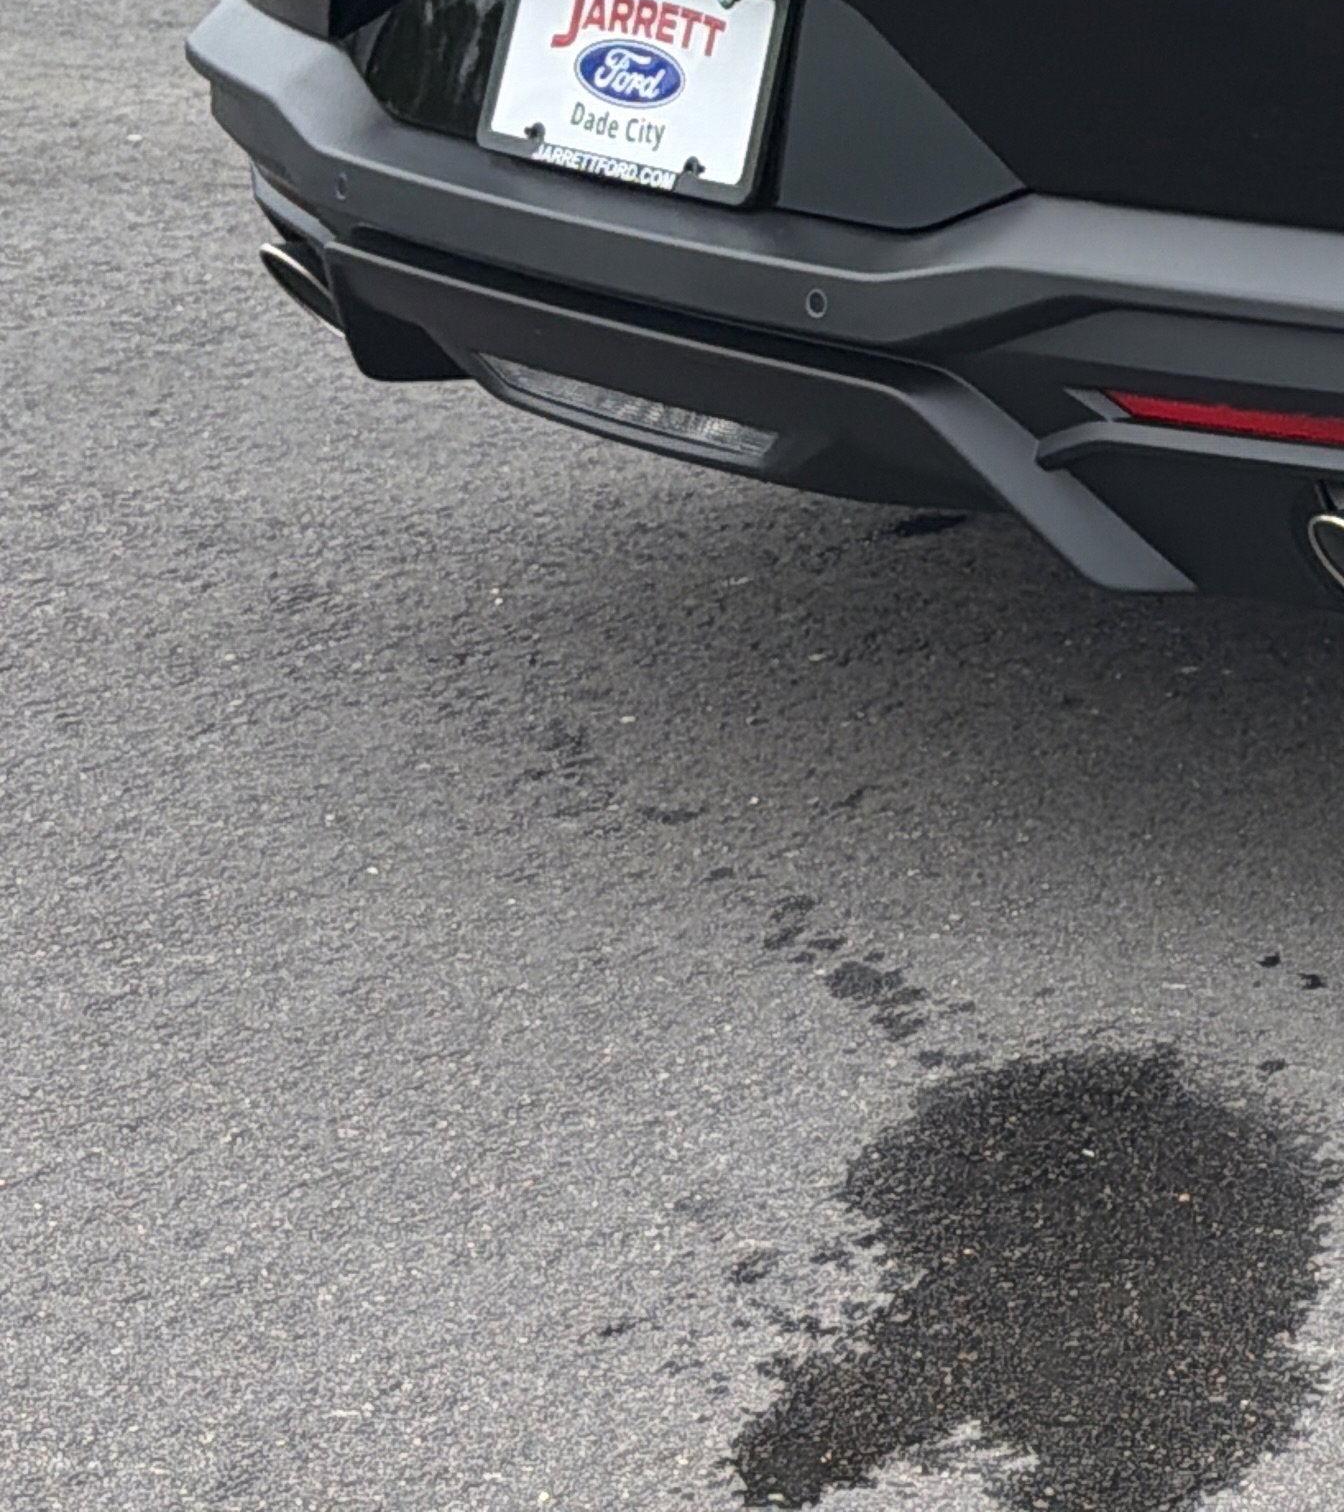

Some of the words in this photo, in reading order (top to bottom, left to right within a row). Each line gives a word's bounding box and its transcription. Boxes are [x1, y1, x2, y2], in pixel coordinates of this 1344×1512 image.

[594, 48, 664, 100] Ford
[570, 101, 620, 139] Dade
[625, 117, 667, 152] City
[530, 143, 678, 191] JARRETTFORD.COM
